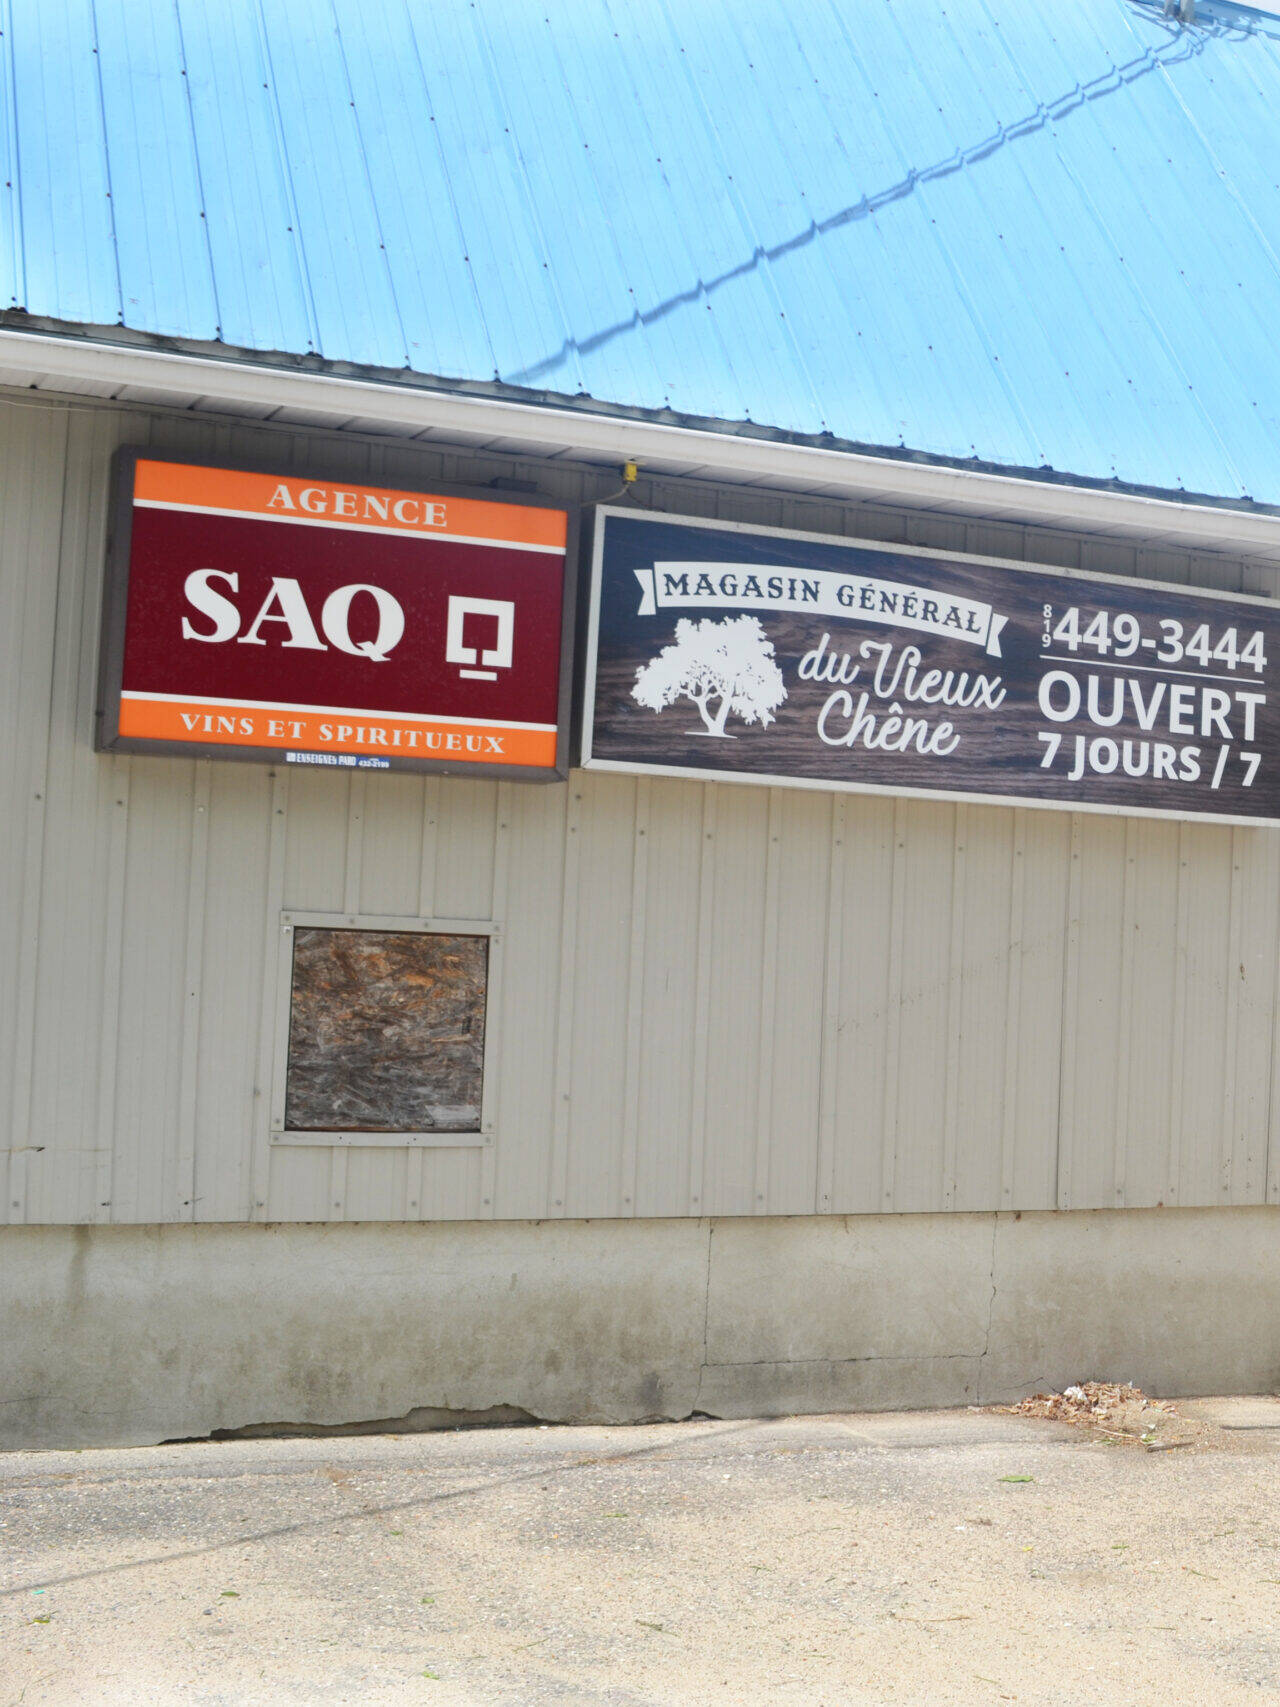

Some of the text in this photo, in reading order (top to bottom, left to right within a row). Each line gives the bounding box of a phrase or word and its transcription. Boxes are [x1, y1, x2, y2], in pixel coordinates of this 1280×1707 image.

[267, 484, 447, 527] AGENCE
[182, 568, 405, 662] SAQ
[664, 573, 982, 633] MAGASIN GÉNÉRAL
[798, 632, 1007, 709] du Vieux
[1053, 607, 1267, 673] 449-3444
[180, 713, 505, 754] VINS ET SPIRITUEUX
[817, 690, 961, 755] Chêne
[1038, 670, 1266, 741] OUVERT
[1038, 732, 1062, 768] 7
[1068, 735, 1201, 782] JOURS
[1240, 752, 1262, 787] 7
